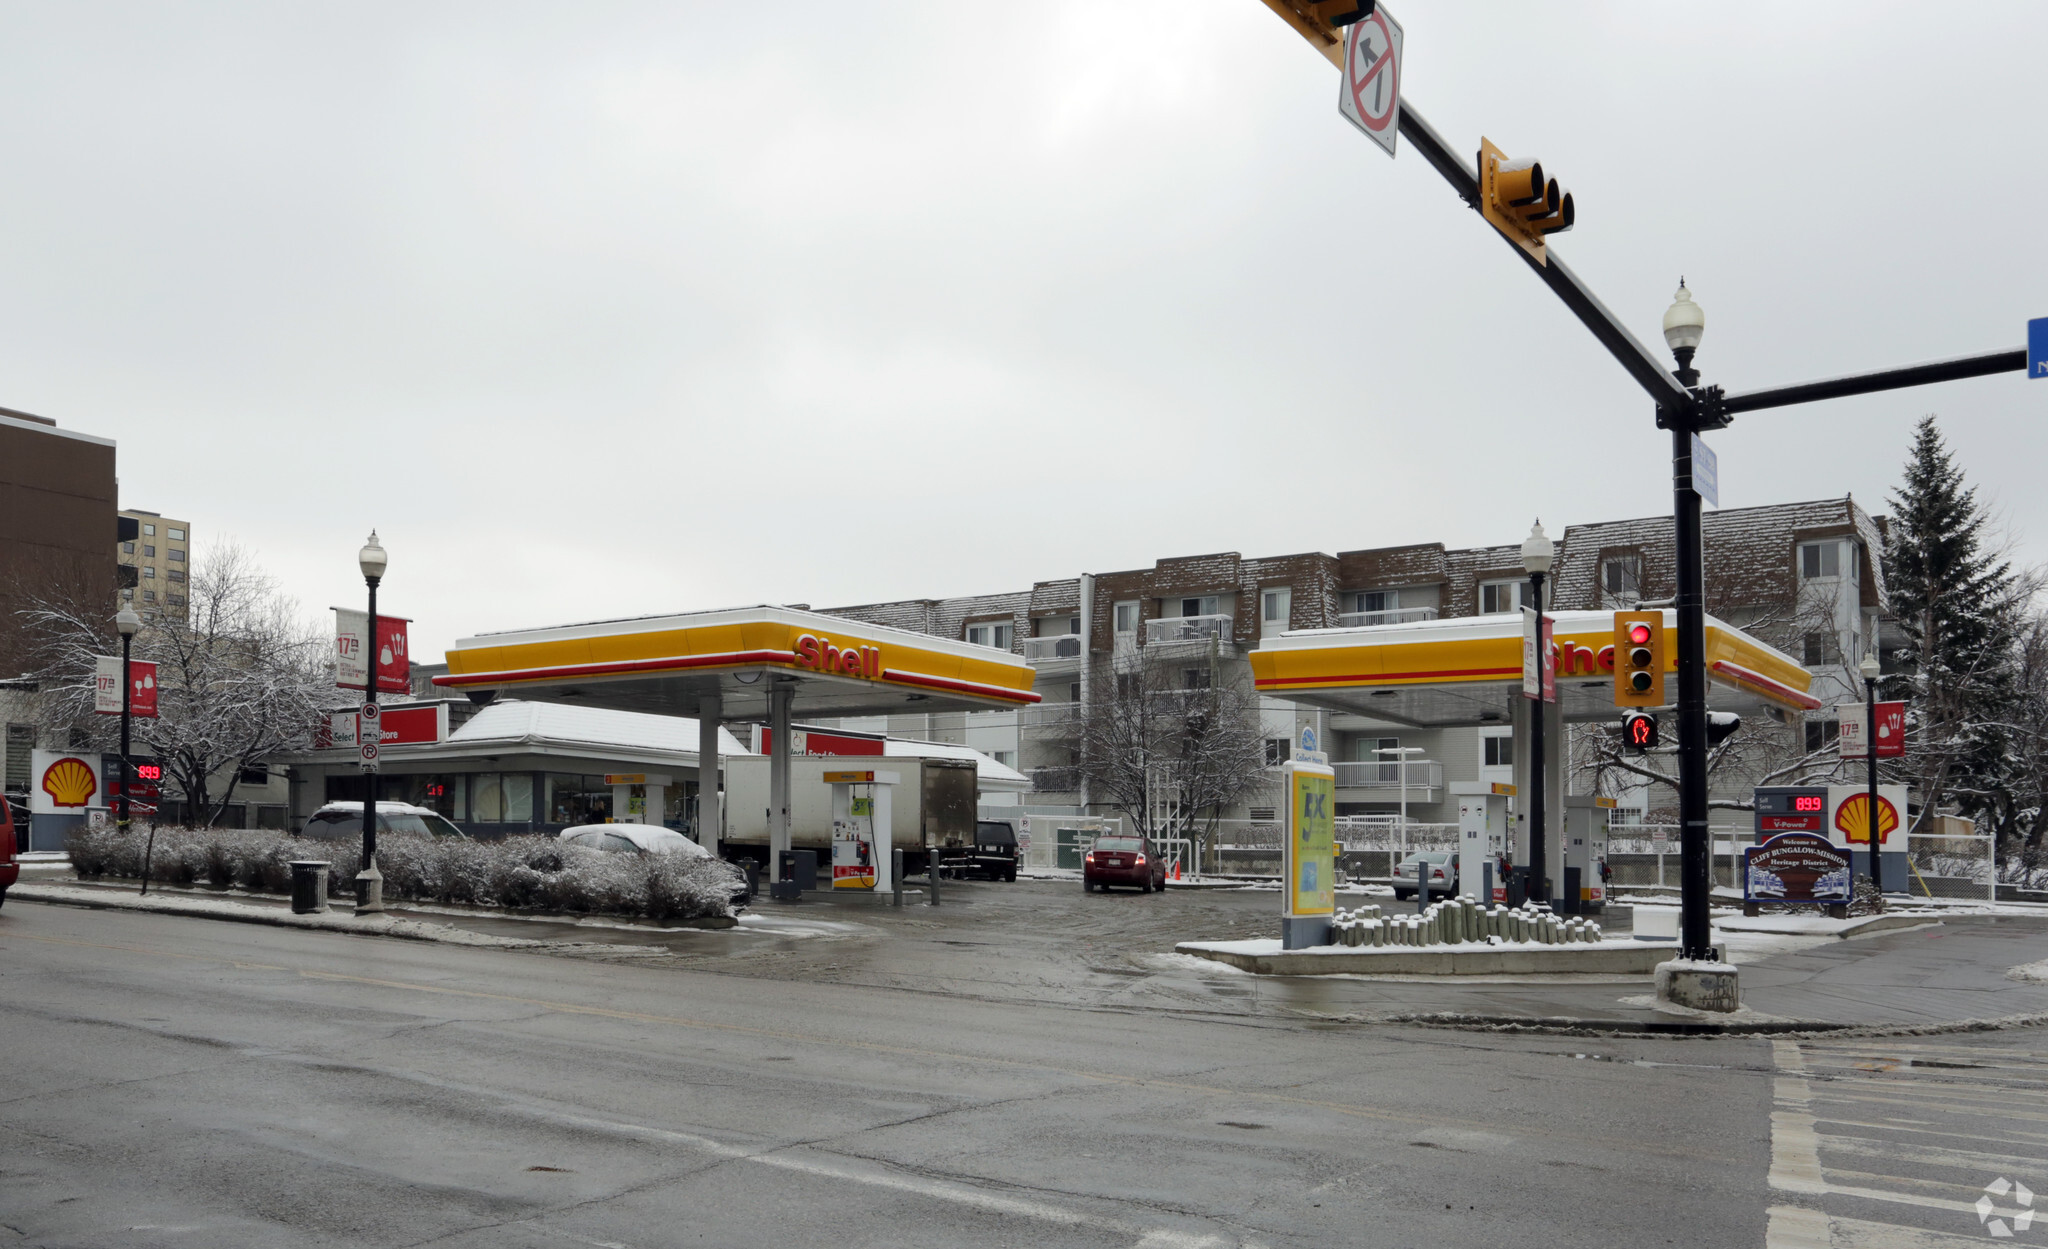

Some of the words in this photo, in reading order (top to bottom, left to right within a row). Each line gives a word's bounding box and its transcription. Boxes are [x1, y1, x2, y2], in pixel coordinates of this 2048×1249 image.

[337, 637, 350, 654] 17
[797, 634, 879, 677] Shell
[98, 677, 108, 690] 17
[334, 731, 355, 742] Select
[1840, 724, 1851, 736] 17
[1750, 851, 1771, 866] CLIFF
[1772, 847, 1849, 867] BUNGALOW-MISSION
